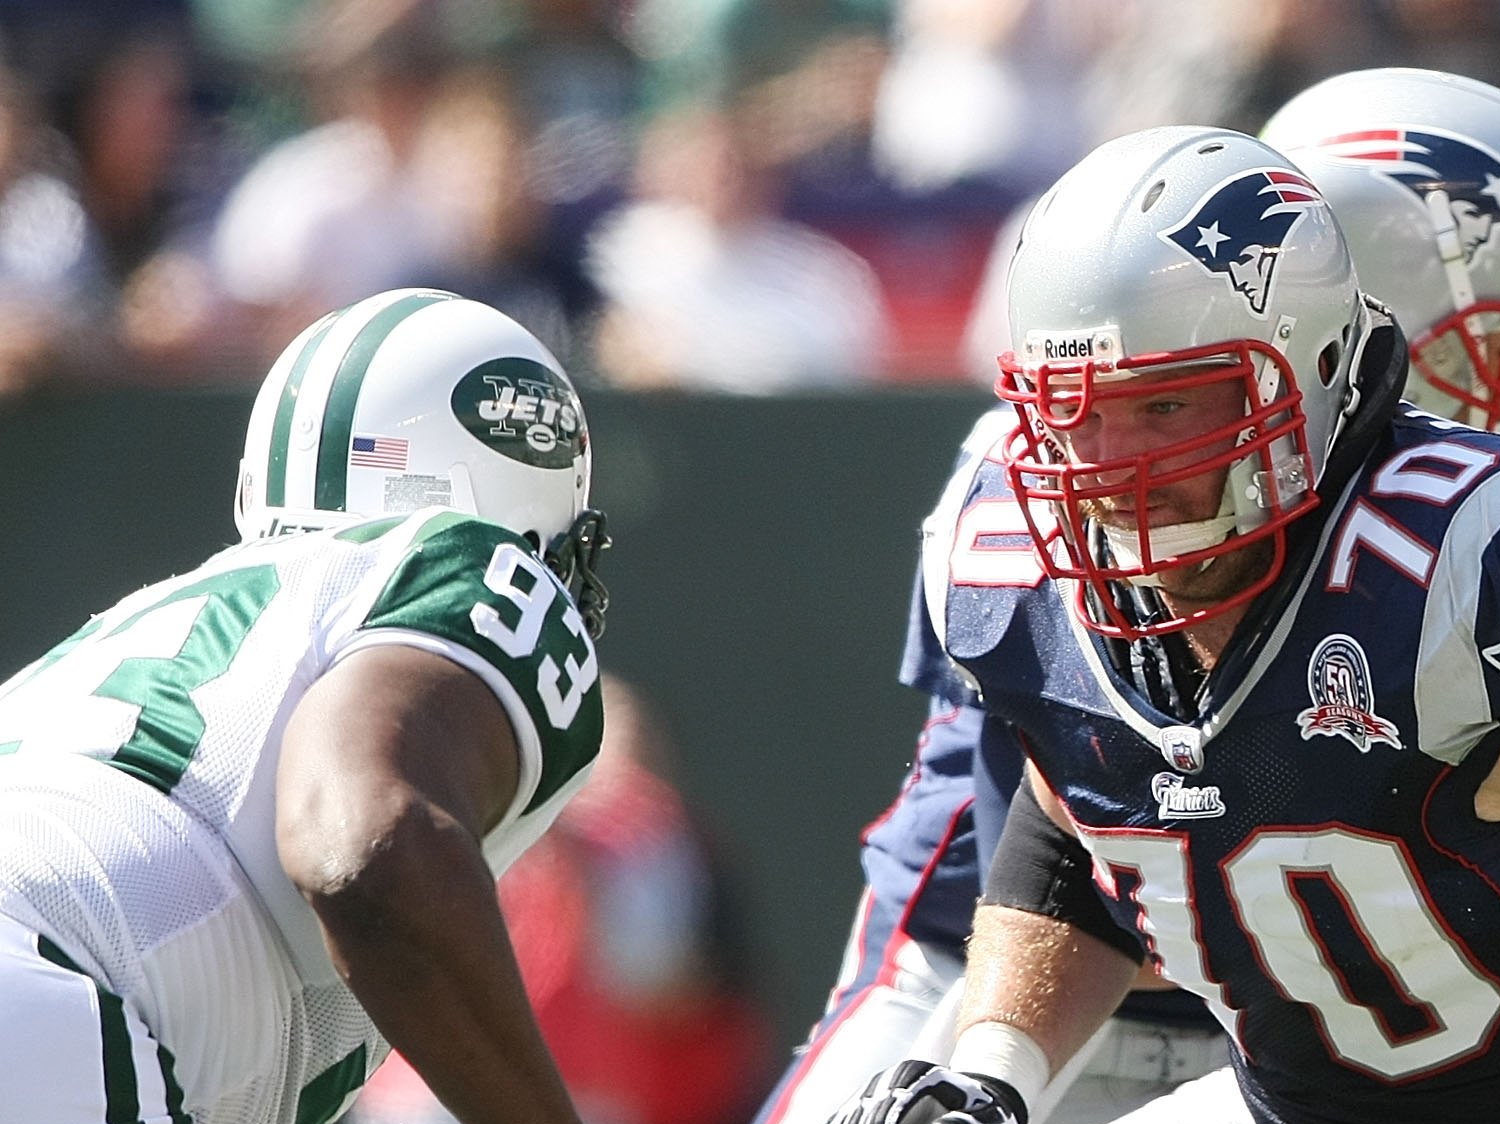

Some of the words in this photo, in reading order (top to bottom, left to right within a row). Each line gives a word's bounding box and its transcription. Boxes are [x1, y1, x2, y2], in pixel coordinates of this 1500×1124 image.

[479, 387, 577, 432] JETS
[1325, 441, 1500, 592] 70
[469, 543, 599, 730] 93
[1152, 771, 1226, 819] Patriots
